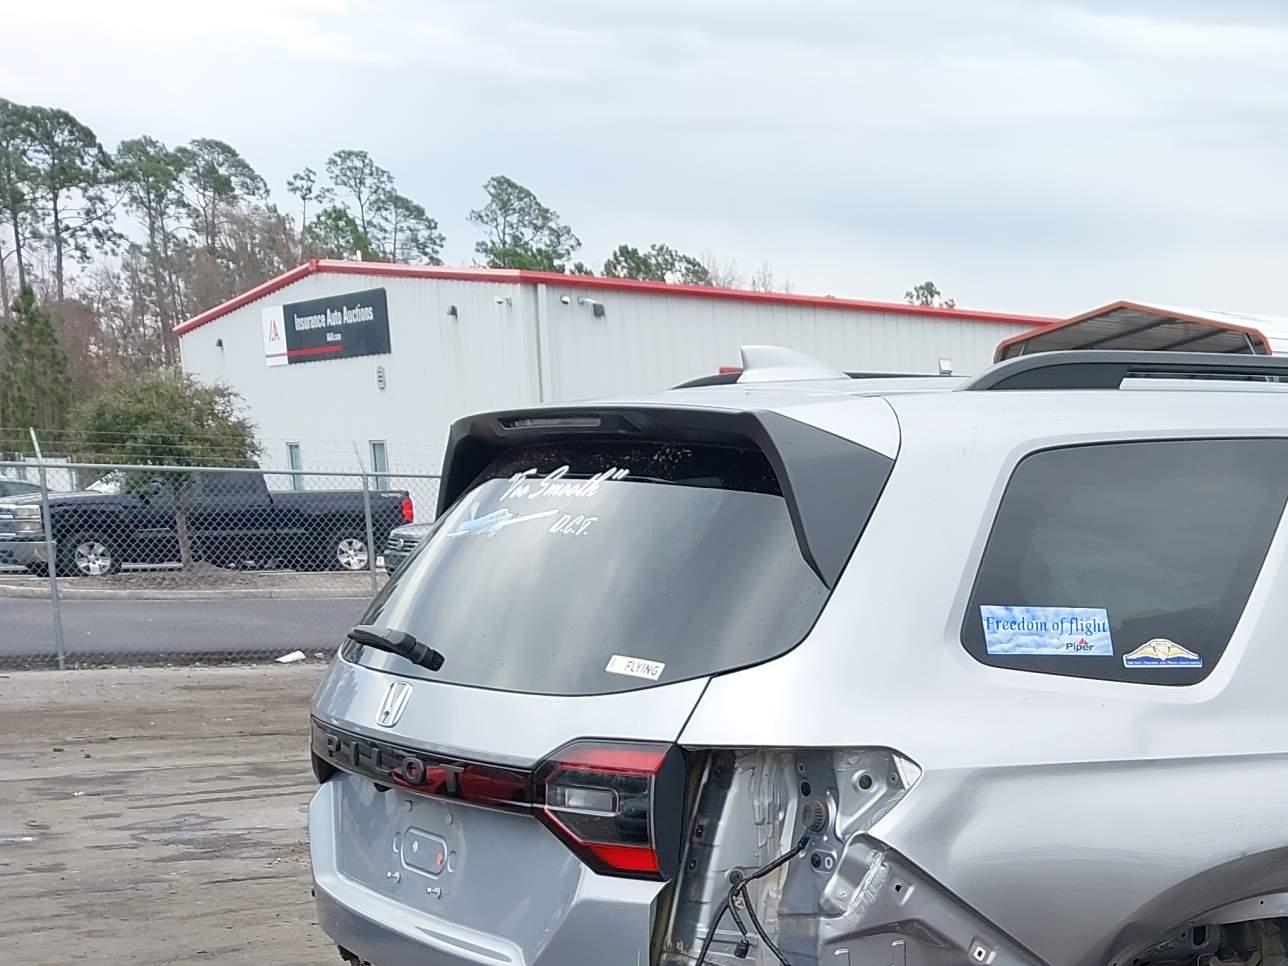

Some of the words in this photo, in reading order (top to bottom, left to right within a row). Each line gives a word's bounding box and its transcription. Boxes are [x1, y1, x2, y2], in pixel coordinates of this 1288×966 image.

[294, 312, 326, 331] Insurance
[326, 308, 342, 326] Auto
[343, 304, 374, 323] Auctions
[984, 616, 1047, 632] Freedom
[1051, 617, 1067, 635] of
[1068, 617, 1107, 636] flight
[1065, 642, 1095, 653] Piper
[624, 660, 660, 676] FLYING
[326, 733, 465, 797] PILOT
